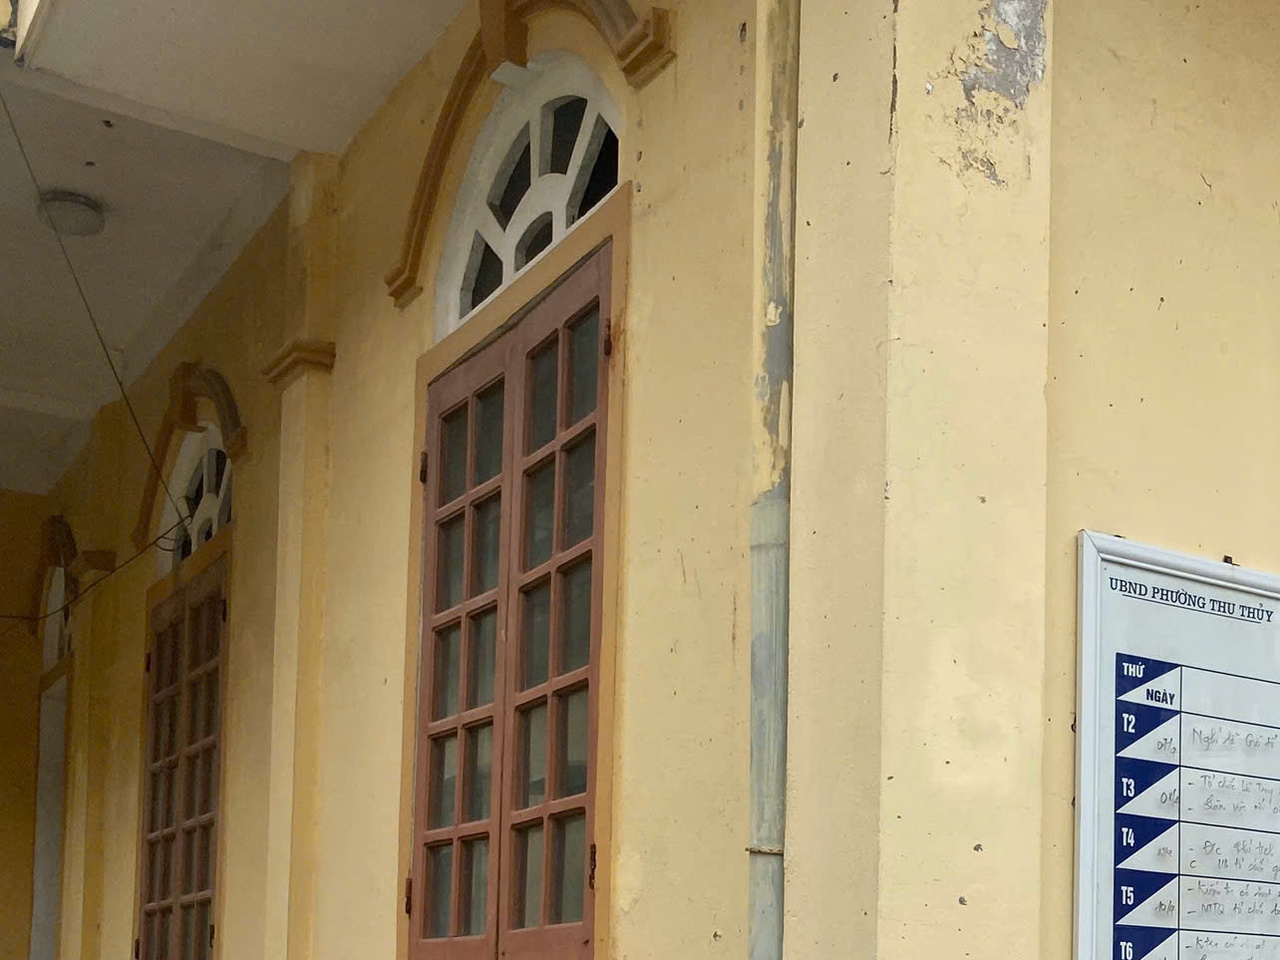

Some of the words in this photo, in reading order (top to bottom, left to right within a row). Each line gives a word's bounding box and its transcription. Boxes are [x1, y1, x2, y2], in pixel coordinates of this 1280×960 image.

[1109, 577, 1148, 596] UBND
[1151, 586, 1206, 609] PHƯỜNG
[1209, 599, 1235, 615] THU
[1239, 603, 1273, 622] THỦY
[1122, 662, 1145, 678] THỨ
[1146, 688, 1175, 705] NGÀY
[1122, 713, 1136, 733] T2
[1121, 778, 1135, 797] T3
[1121, 828, 1135, 847] T4
[1121, 886, 1134, 905] T5
[1120, 941, 1133, 960] T6
